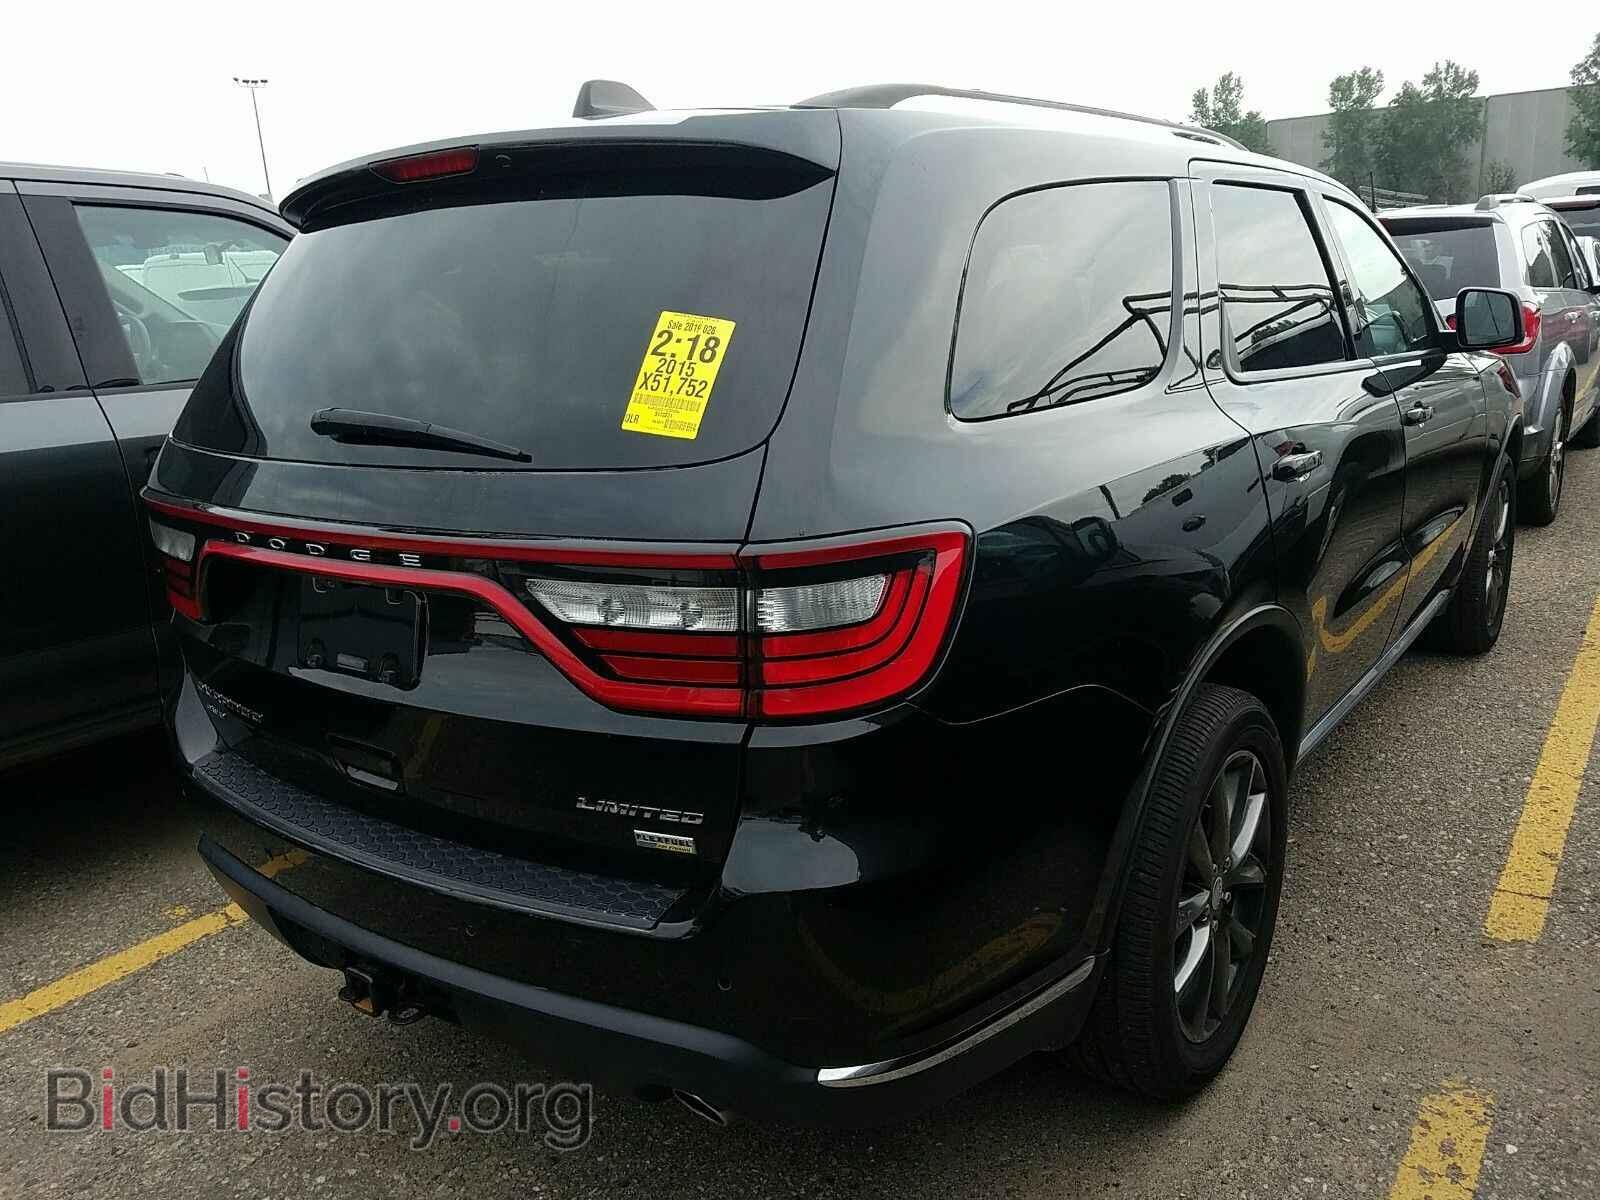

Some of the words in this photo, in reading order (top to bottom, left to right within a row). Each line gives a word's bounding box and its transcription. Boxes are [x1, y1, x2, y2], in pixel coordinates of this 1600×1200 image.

[667, 320, 682, 331] Sale
[650, 329, 721, 363] 2:18
[655, 358, 697, 378] 2015
[639, 371, 708, 398] X51,752
[234, 531, 422, 567] DODGE
[576, 796, 704, 825] LIMITED
